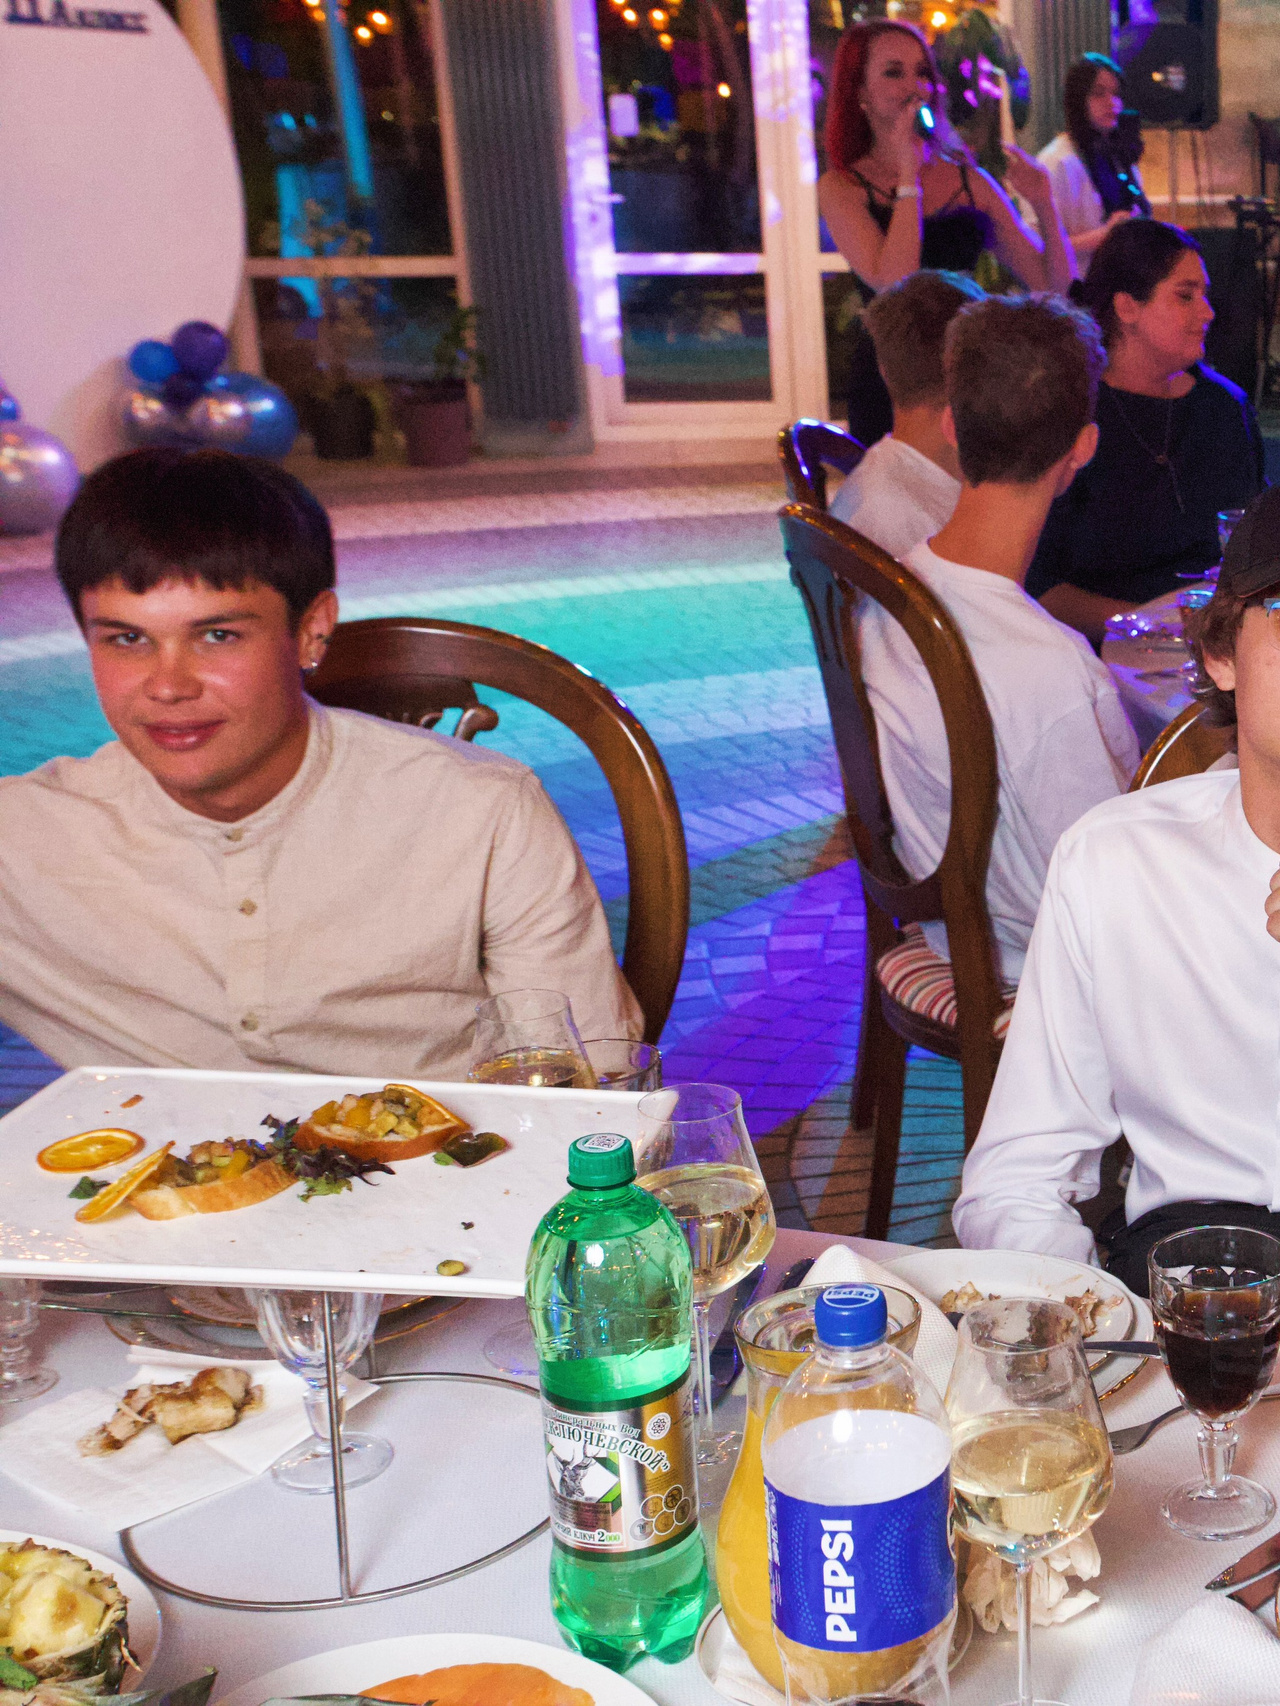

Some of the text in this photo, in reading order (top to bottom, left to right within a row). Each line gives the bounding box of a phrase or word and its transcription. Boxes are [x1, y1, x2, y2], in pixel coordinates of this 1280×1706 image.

[827, 1289, 876, 1299] PEPSI
[620, 1423, 642, 1439] Вод
[819, 1518, 858, 1642] PEPSI
